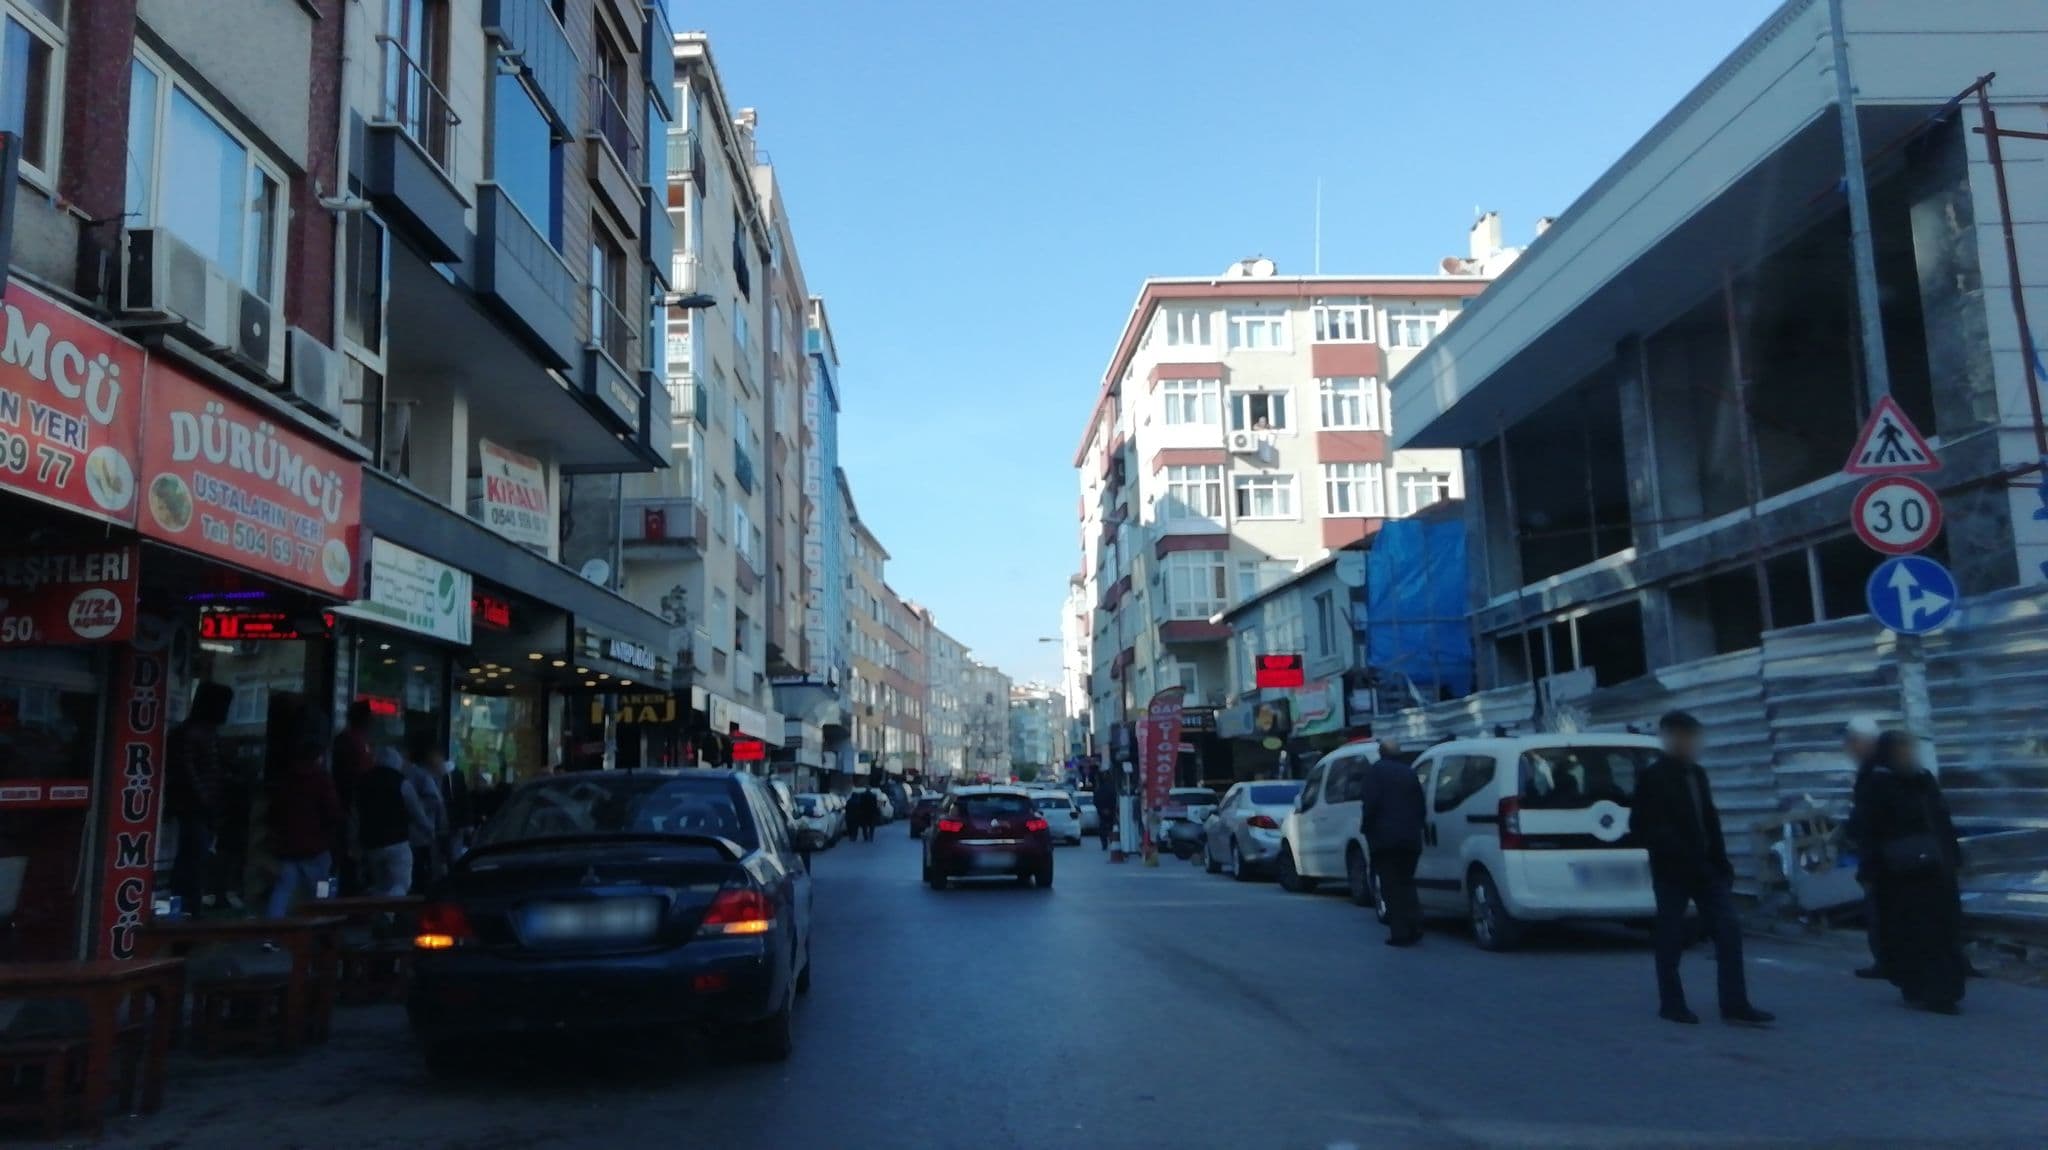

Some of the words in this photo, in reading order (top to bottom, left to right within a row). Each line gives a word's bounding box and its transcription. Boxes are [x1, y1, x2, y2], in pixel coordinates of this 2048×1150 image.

[0, 301, 121, 425] MCÜ
[28, 400, 89, 453] YERİ
[37, 446, 75, 489] 77
[171, 402, 343, 522] DÜRÜMCÜ
[193, 474, 287, 530] USTALARIN
[289, 512, 325, 545] YERİ
[1872, 499, 1923, 533] 30
[0, 546, 129, 592] EŞİTLERİ
[233, 520, 267, 557] 504
[271, 535, 292, 566] 69
[295, 543, 317, 573] 77
[75, 597, 116, 616] 7/24
[111, 654, 161, 961] DÜRÜMCÜ
